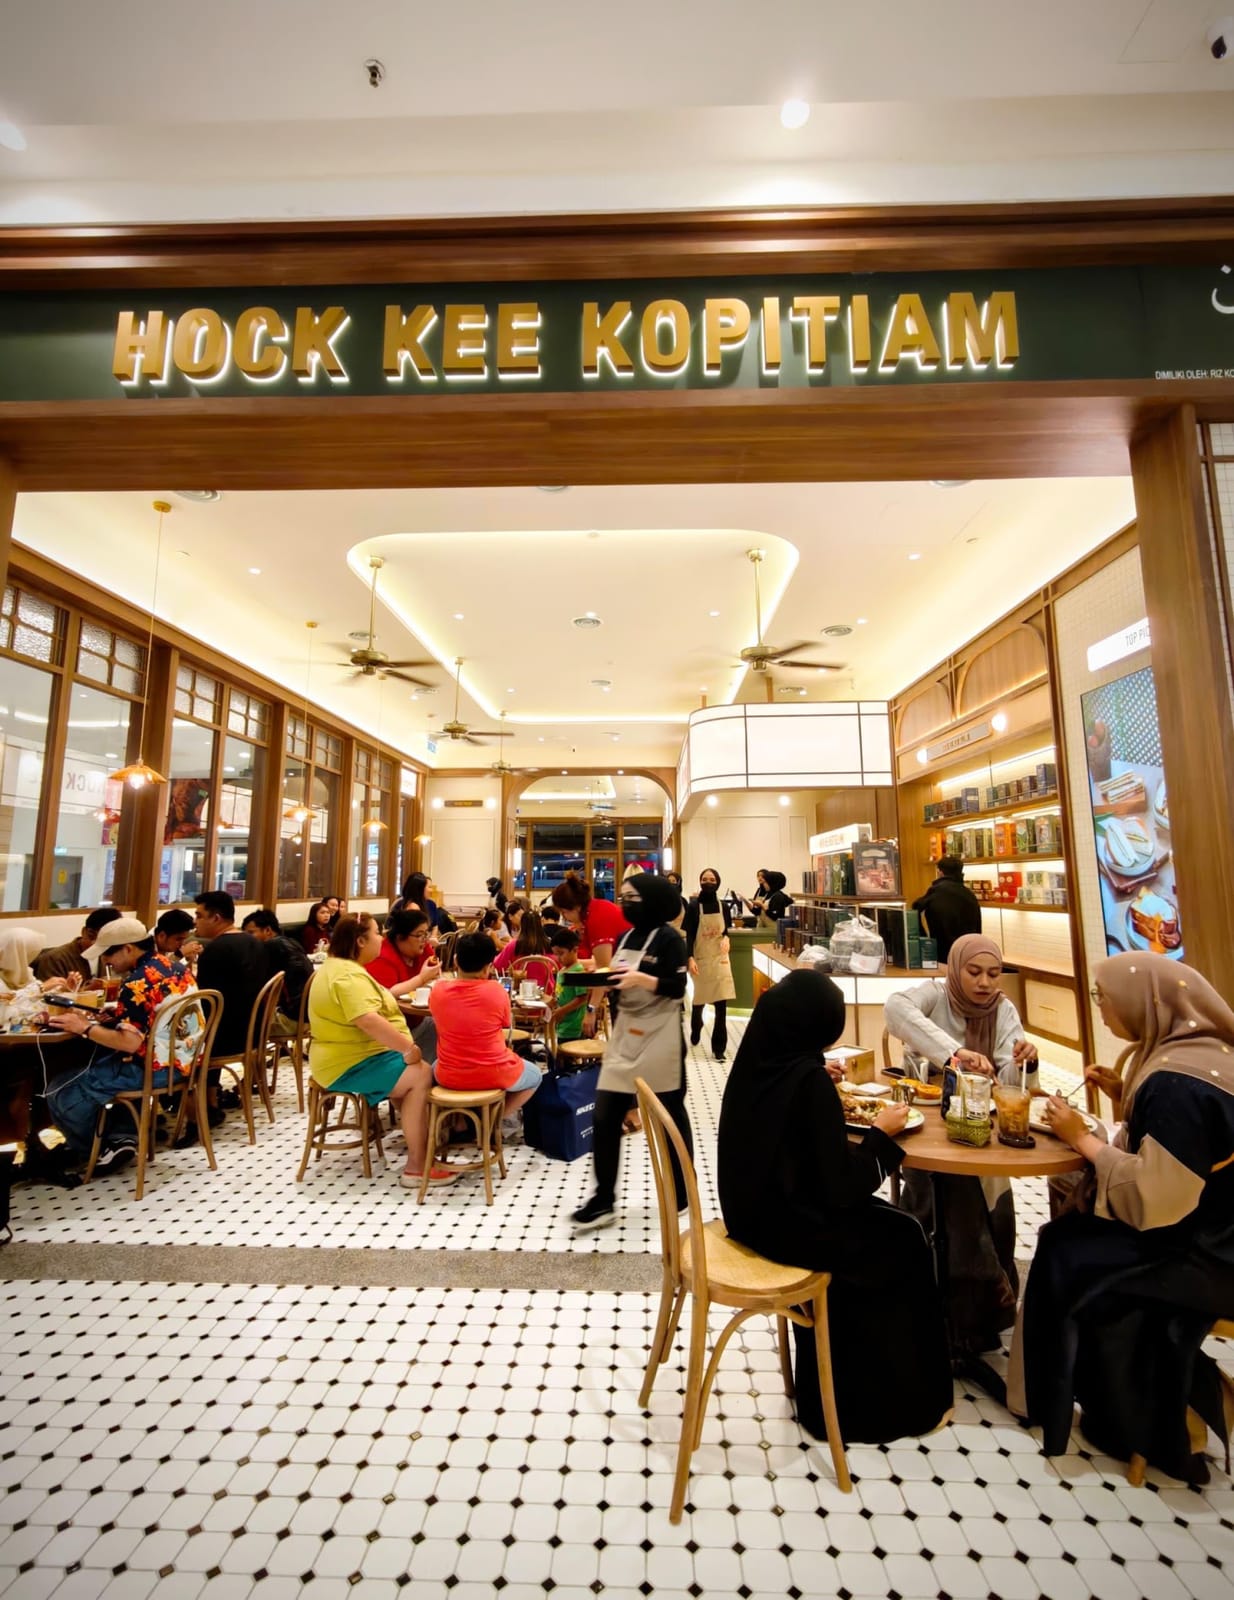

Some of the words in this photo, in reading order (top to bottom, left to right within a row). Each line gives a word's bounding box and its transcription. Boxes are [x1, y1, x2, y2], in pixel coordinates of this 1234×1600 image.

[112, 306, 350, 386] HOCK
[383, 303, 542, 381] KEE
[582, 291, 1019, 378] KOPITIAM
[1155, 370, 1185, 380] DIMILIKI
[1125, 631, 1138, 648] TOP
